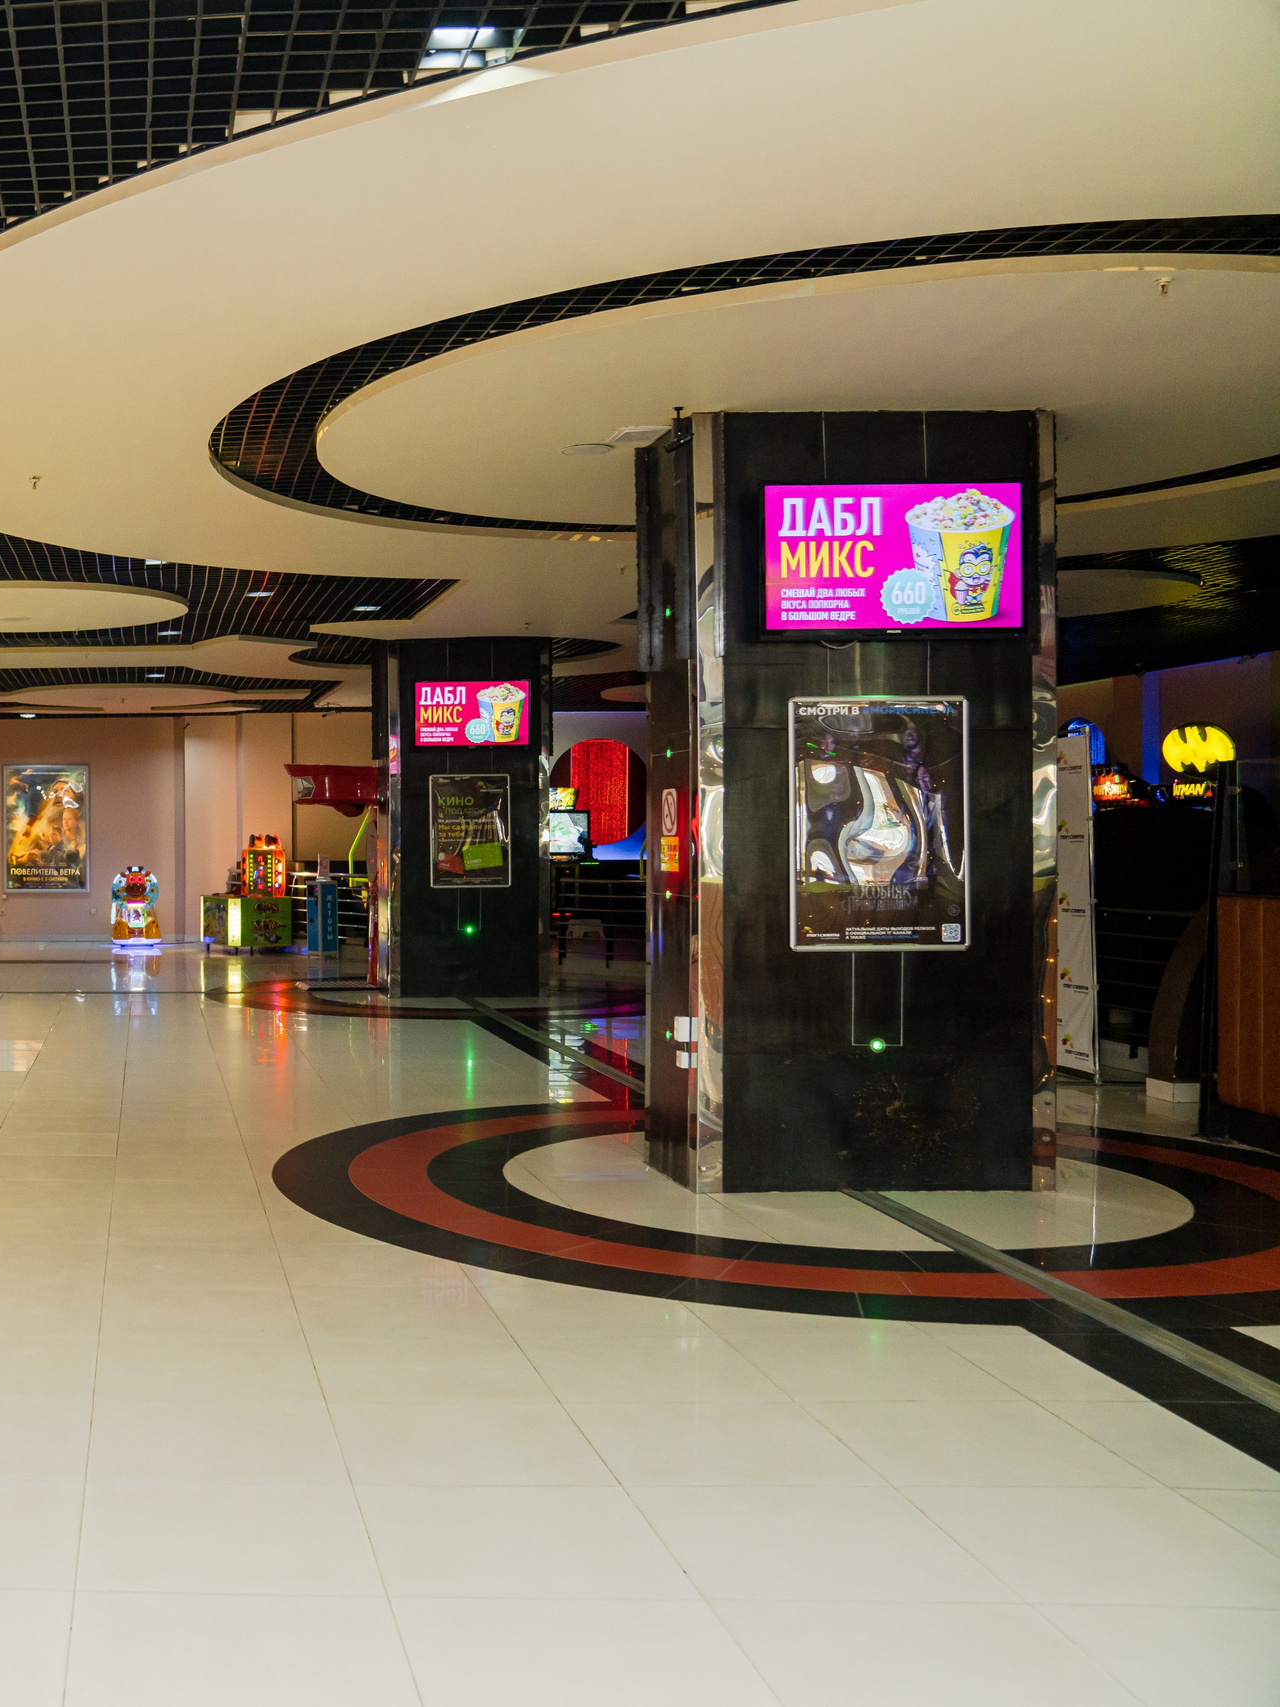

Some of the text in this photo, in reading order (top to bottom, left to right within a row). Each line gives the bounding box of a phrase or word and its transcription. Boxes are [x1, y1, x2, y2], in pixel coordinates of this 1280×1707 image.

[778, 497, 881, 537] ДАБЛ
[781, 540, 875, 578] МИКС
[781, 587, 866, 599] СМЕШАЙ ДВА ЛЮБЫХ
[891, 582, 926, 604] 660
[781, 600, 850, 609] ВКУСА ПОПКОРНА
[781, 611, 856, 621] В БОЛЬШОМ ВЕДРЕ
[419, 686, 466, 705] ДАБЛ
[420, 706, 462, 723] МИКС
[799, 707, 848, 716] СМОТРИ
[852, 707, 860, 715] В
[470, 725, 486, 735] 660
[438, 797, 474, 806] КИНО
[853, 884, 911, 899] ОСОБНЯК
[325, 895, 333, 939] ЖЕТОНЫ
